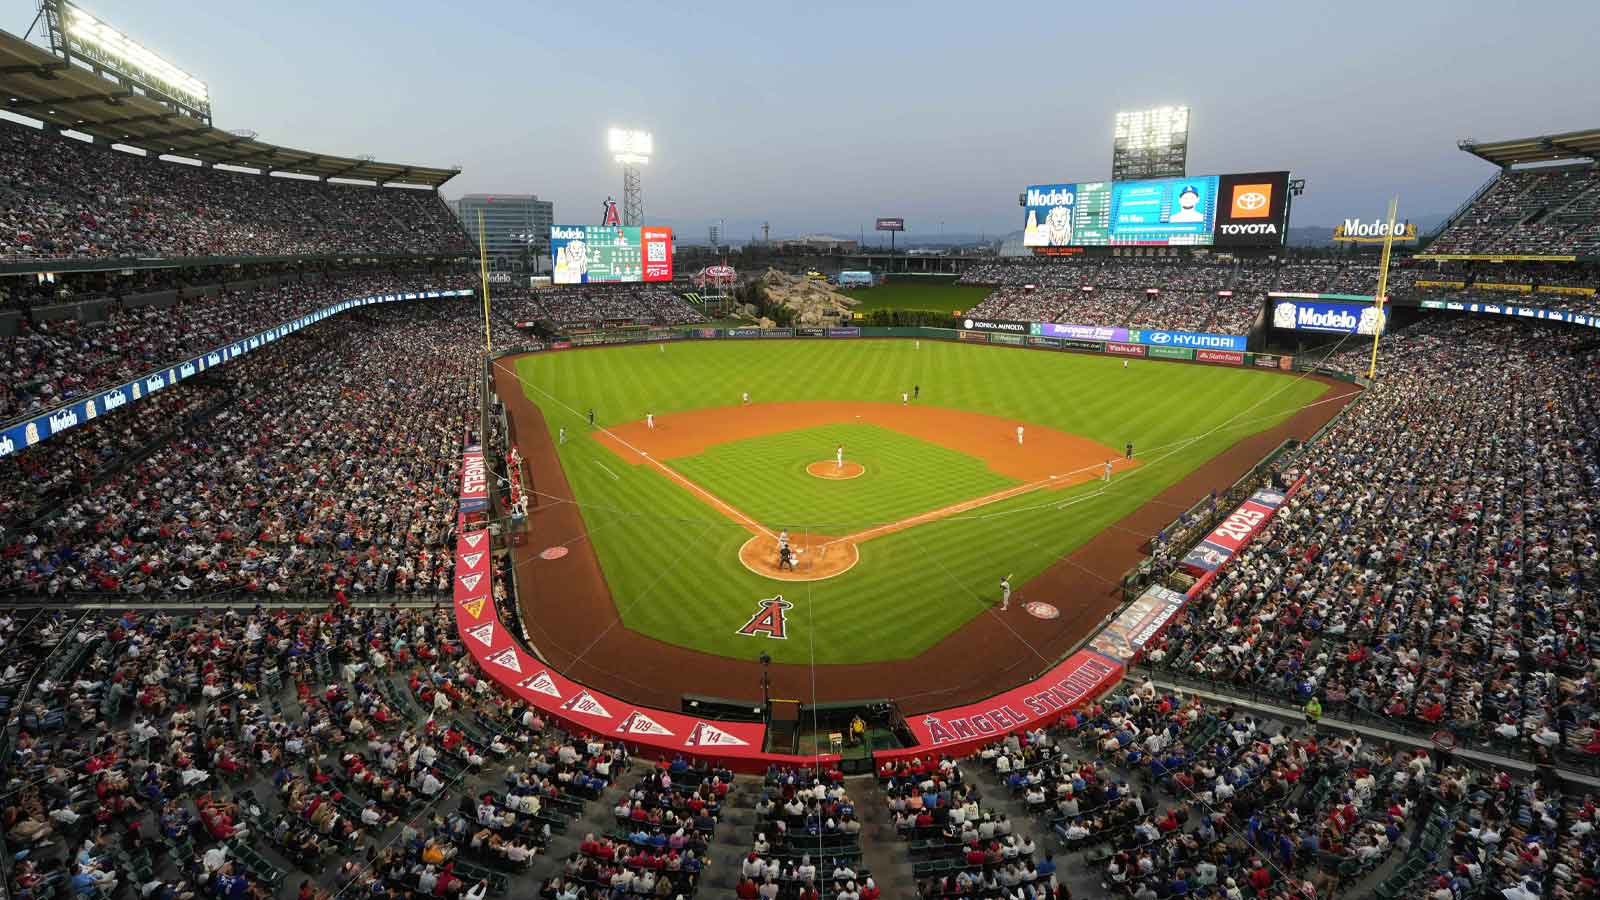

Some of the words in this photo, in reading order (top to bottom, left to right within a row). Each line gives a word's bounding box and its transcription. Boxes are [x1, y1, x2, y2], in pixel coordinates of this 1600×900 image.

[1027, 188, 1074, 206] Modelo
[551, 226, 585, 240] Modelo
[1221, 224, 1277, 235] TOYOTA
[1343, 218, 1405, 236] Modelo
[975, 322, 997, 330] KONICA
[998, 323, 1025, 331] MINOLTA
[1298, 307, 1357, 327] Modelo
[1173, 332, 1234, 347] HYUNDAI
[49, 410, 77, 434] Modelo
[464, 456, 486, 494] ANGELS
[1215, 506, 1266, 542] 2025
[736, 594, 795, 640] A
[1132, 604, 1178, 645] BOBBLEHEAD
[924, 705, 1029, 744] ANGEL
[1024, 658, 1117, 716] STADIUM
